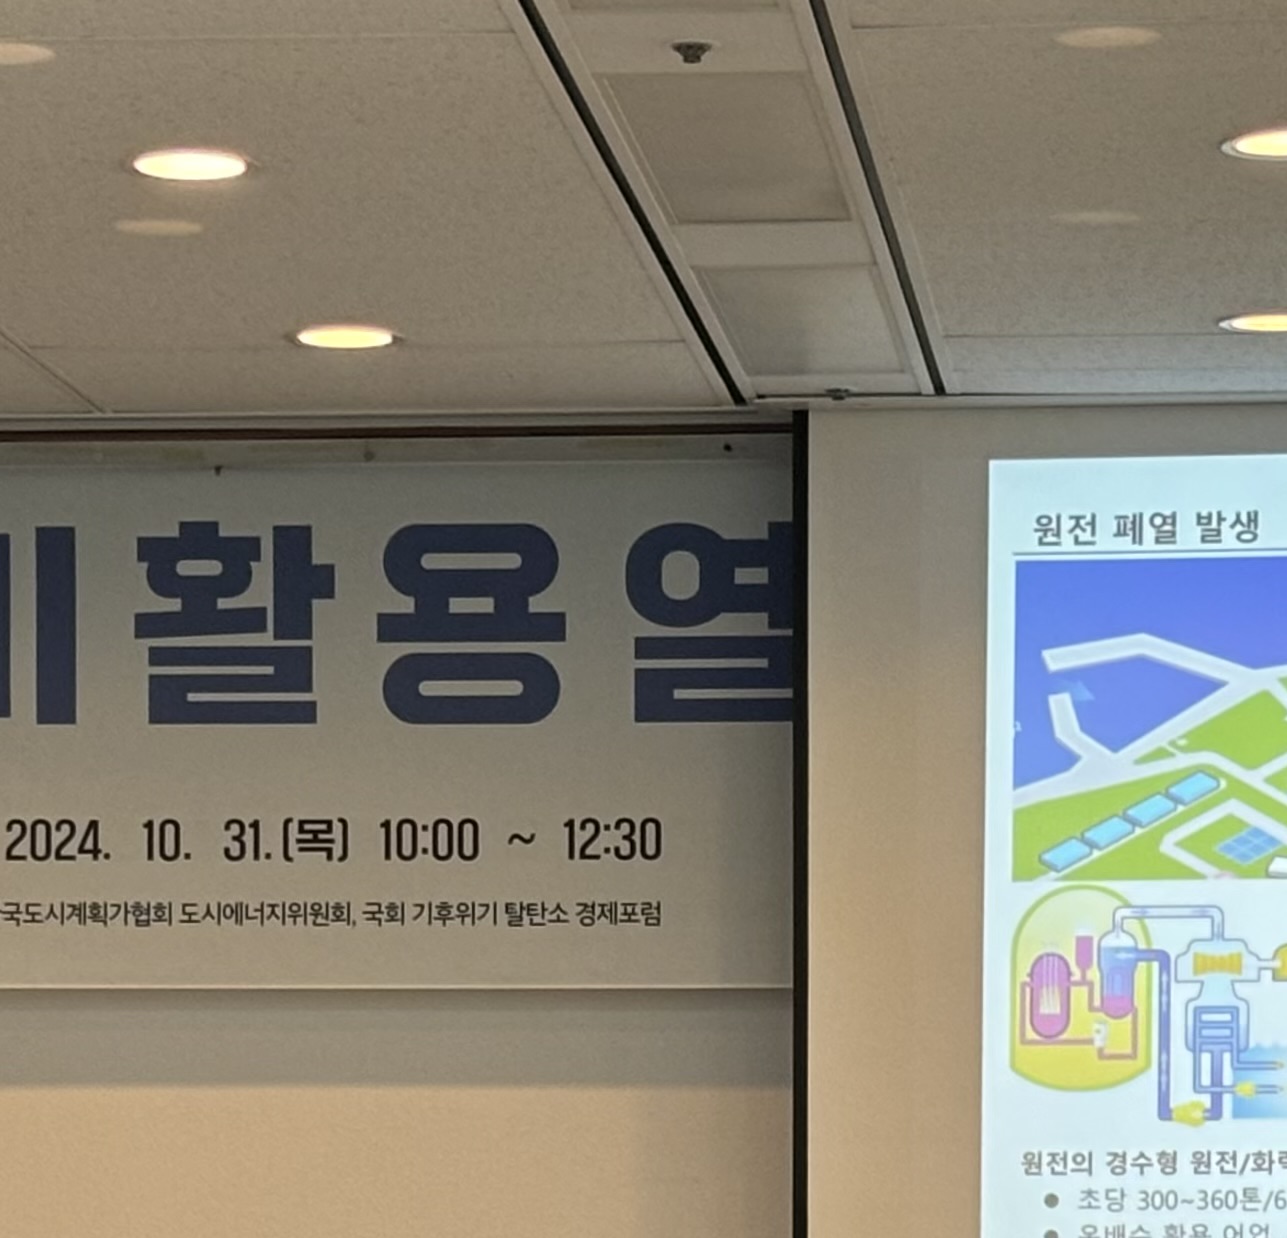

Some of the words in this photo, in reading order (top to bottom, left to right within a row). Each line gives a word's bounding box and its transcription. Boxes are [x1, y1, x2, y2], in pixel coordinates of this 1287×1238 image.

[1033, 512, 1097, 547] 원전
[1195, 509, 1259, 544] 발생
[5, 818, 112, 862] 2024.
[142, 818, 192, 862] 10.
[379, 817, 480, 862] 10:00
[563, 817, 662, 861] 12:30
[178, 901, 357, 928] 도시에너지위원회,
[361, 901, 405, 928] 국회
[412, 900, 498, 928] 기후위기
[504, 900, 570, 928] 탈탄소
[575, 900, 661, 928] 경제포럼
[1021, 1150, 1093, 1177] 원전의
[1106, 1150, 1178, 1177] 경수형
[1078, 1187, 1127, 1213] 초당
